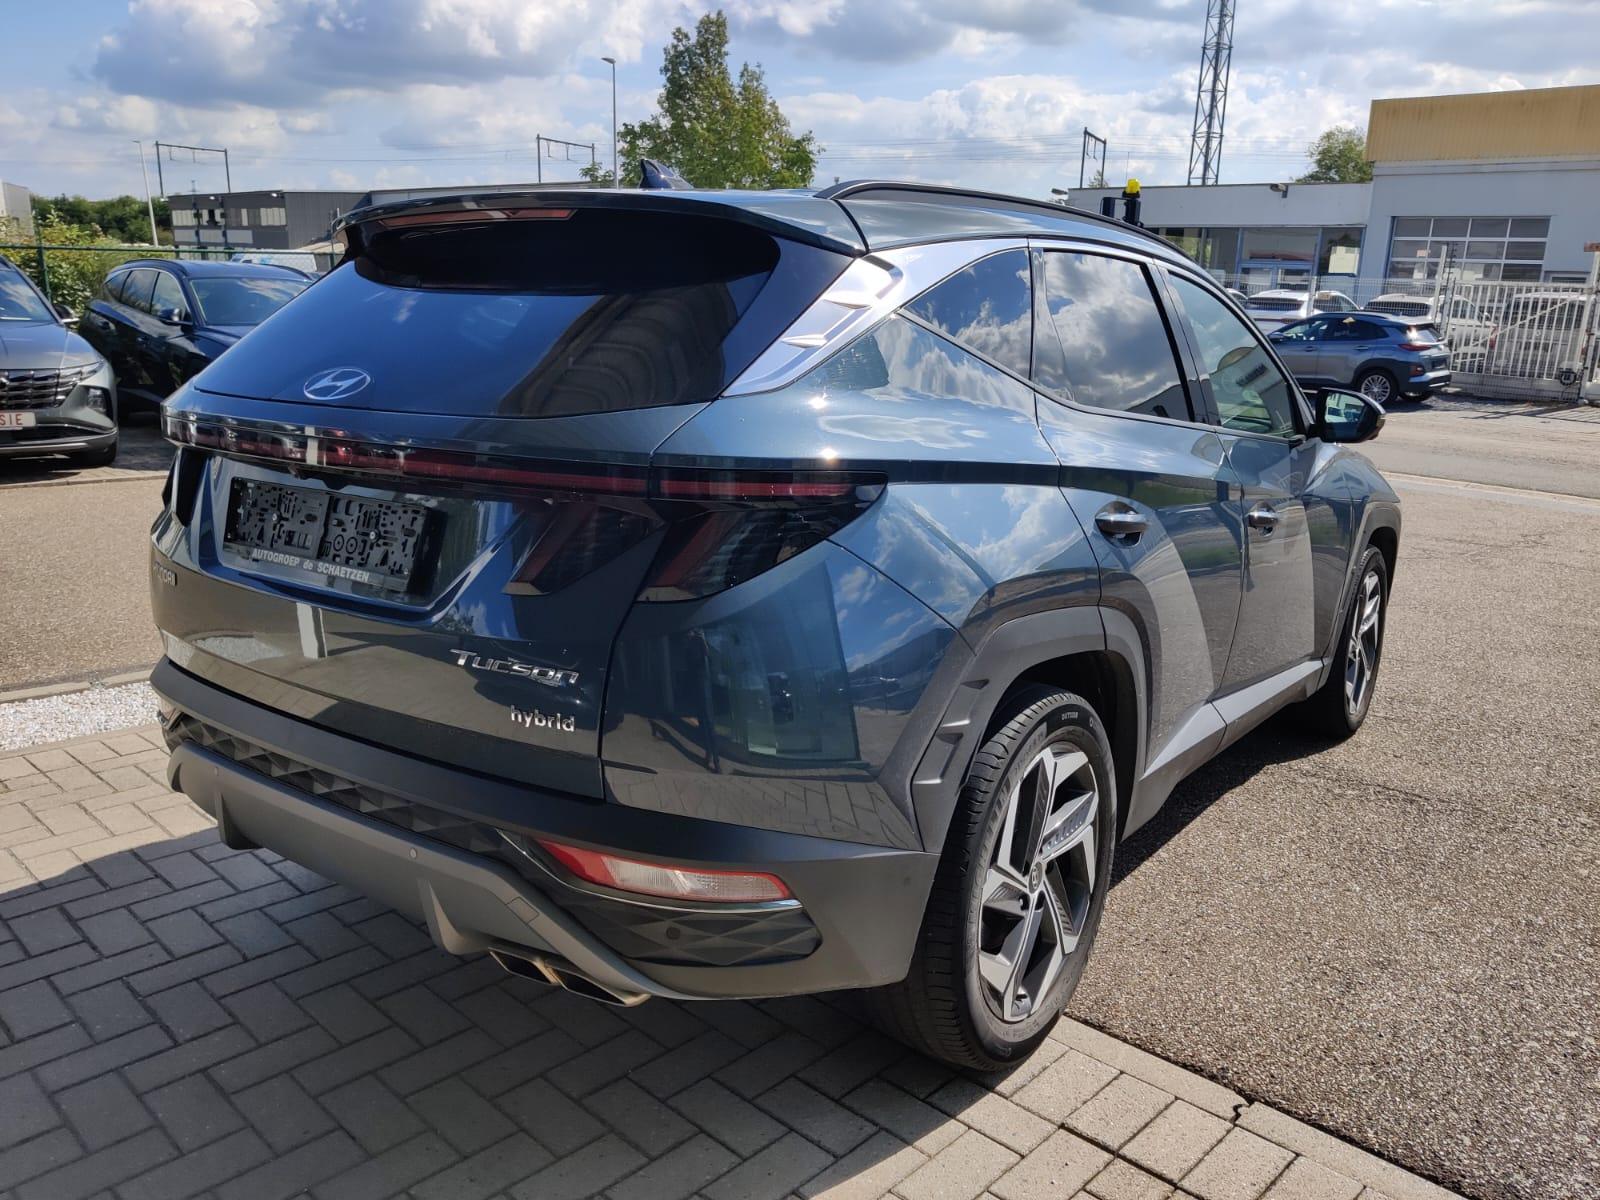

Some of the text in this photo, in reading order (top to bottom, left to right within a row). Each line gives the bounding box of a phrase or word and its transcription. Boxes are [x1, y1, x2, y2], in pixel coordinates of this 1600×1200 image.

[251, 548, 370, 582] AUTOGROEP de SCHAETZEN
[510, 704, 576, 732] hybrid
